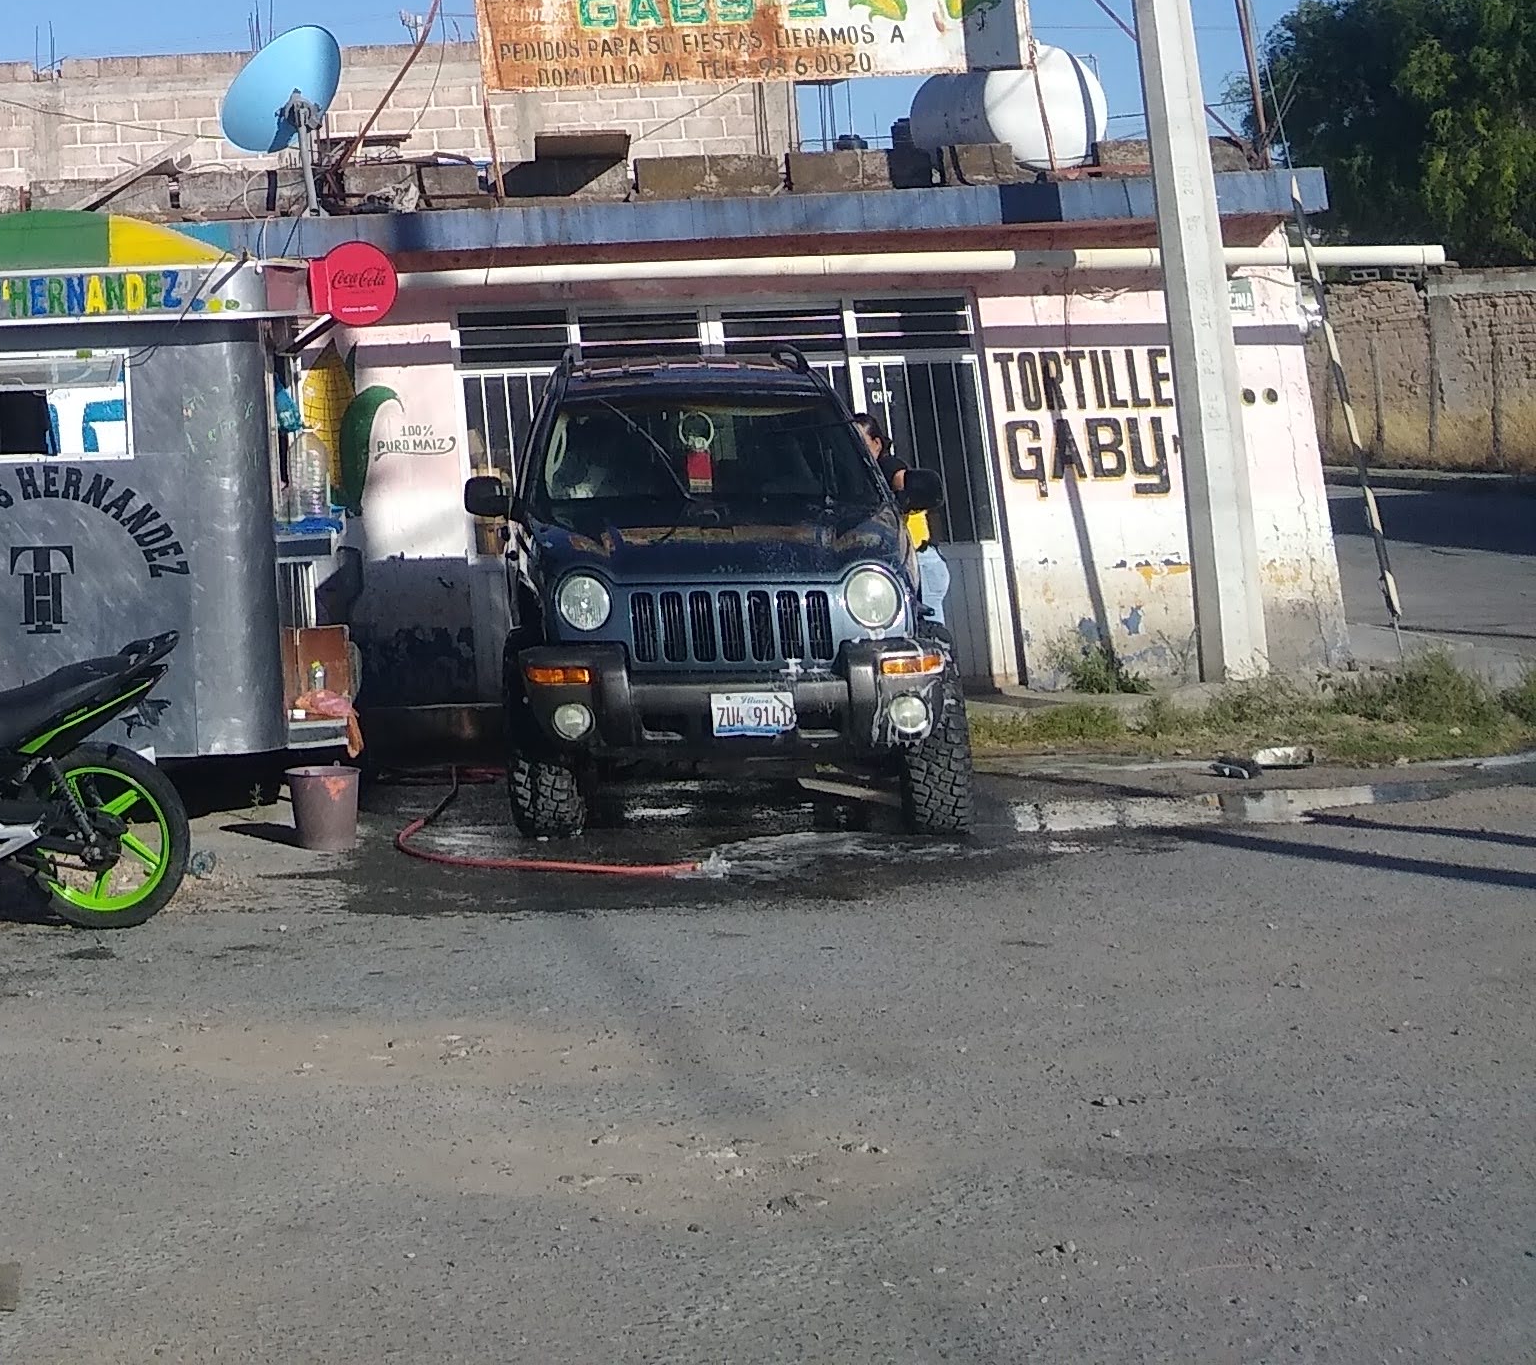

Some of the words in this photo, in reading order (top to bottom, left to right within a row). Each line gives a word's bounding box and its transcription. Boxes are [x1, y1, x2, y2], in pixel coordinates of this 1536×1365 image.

[500, 39, 580, 63] PEDIDOS
[588, 36, 641, 59] PARA
[682, 31, 762, 54] FIESTAS
[890, 24, 905, 44] A
[663, 61, 687, 81] AL
[400, 424, 434, 437] 100%
[377, 439, 410, 452] PURO
[413, 438, 445, 451] MAIZ
[1005, 416, 1171, 498] GABY
[15, 465, 190, 578] HERNANDEZ
[717, 706, 744, 727] ZU4
